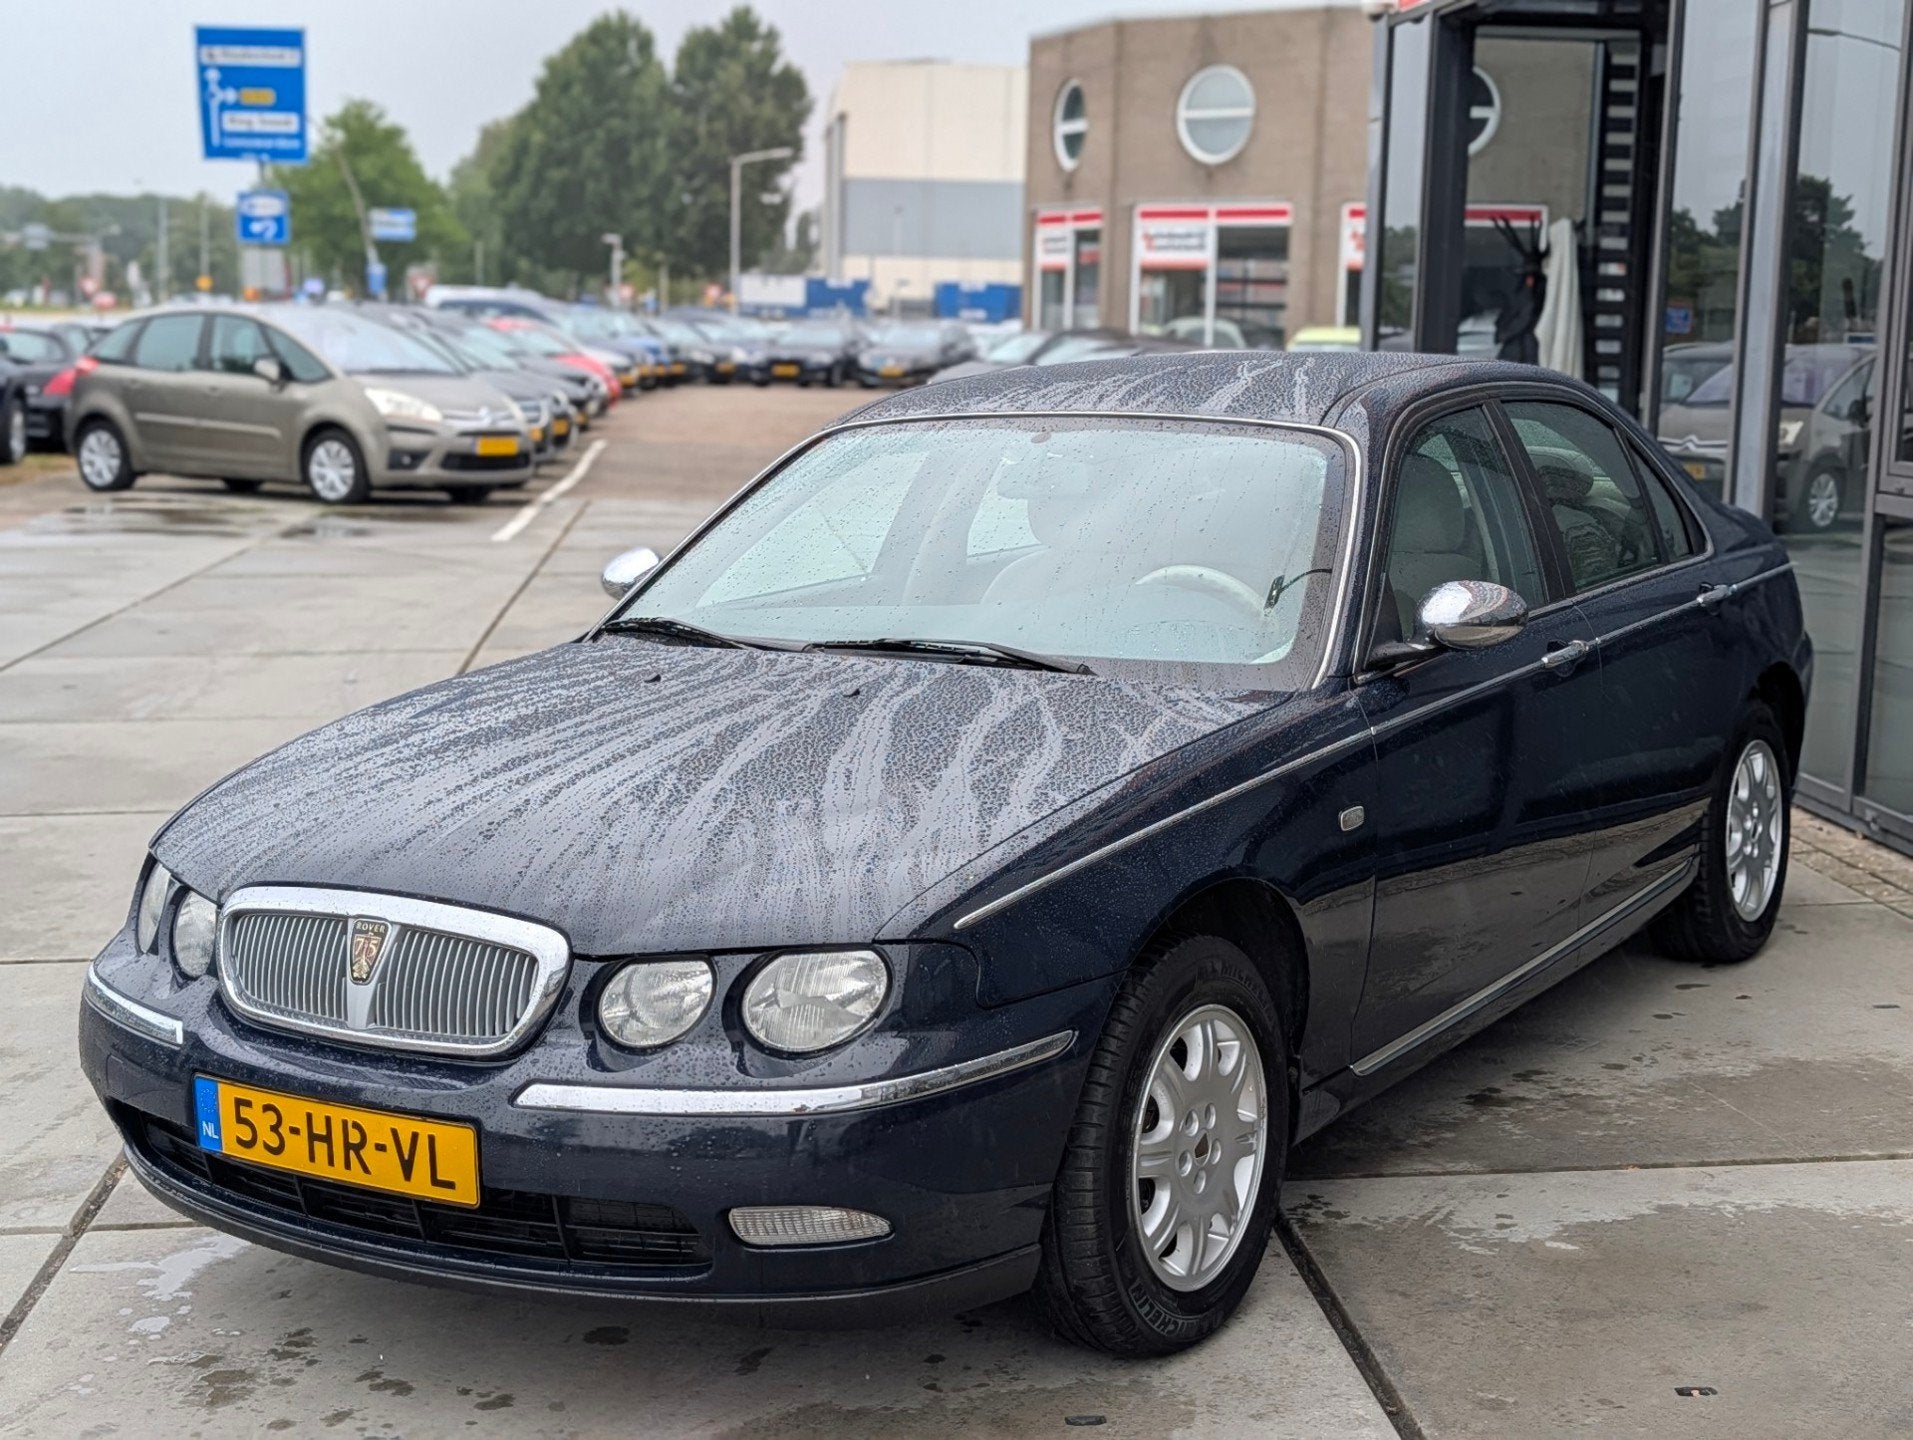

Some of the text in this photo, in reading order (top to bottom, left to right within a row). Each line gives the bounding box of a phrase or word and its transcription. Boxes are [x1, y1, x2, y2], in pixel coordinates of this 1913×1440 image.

[356, 921, 386, 934] ROVER
[355, 937, 377, 957] 75
[202, 1120, 219, 1139] NL
[234, 1096, 456, 1190] 53-HR-VL
